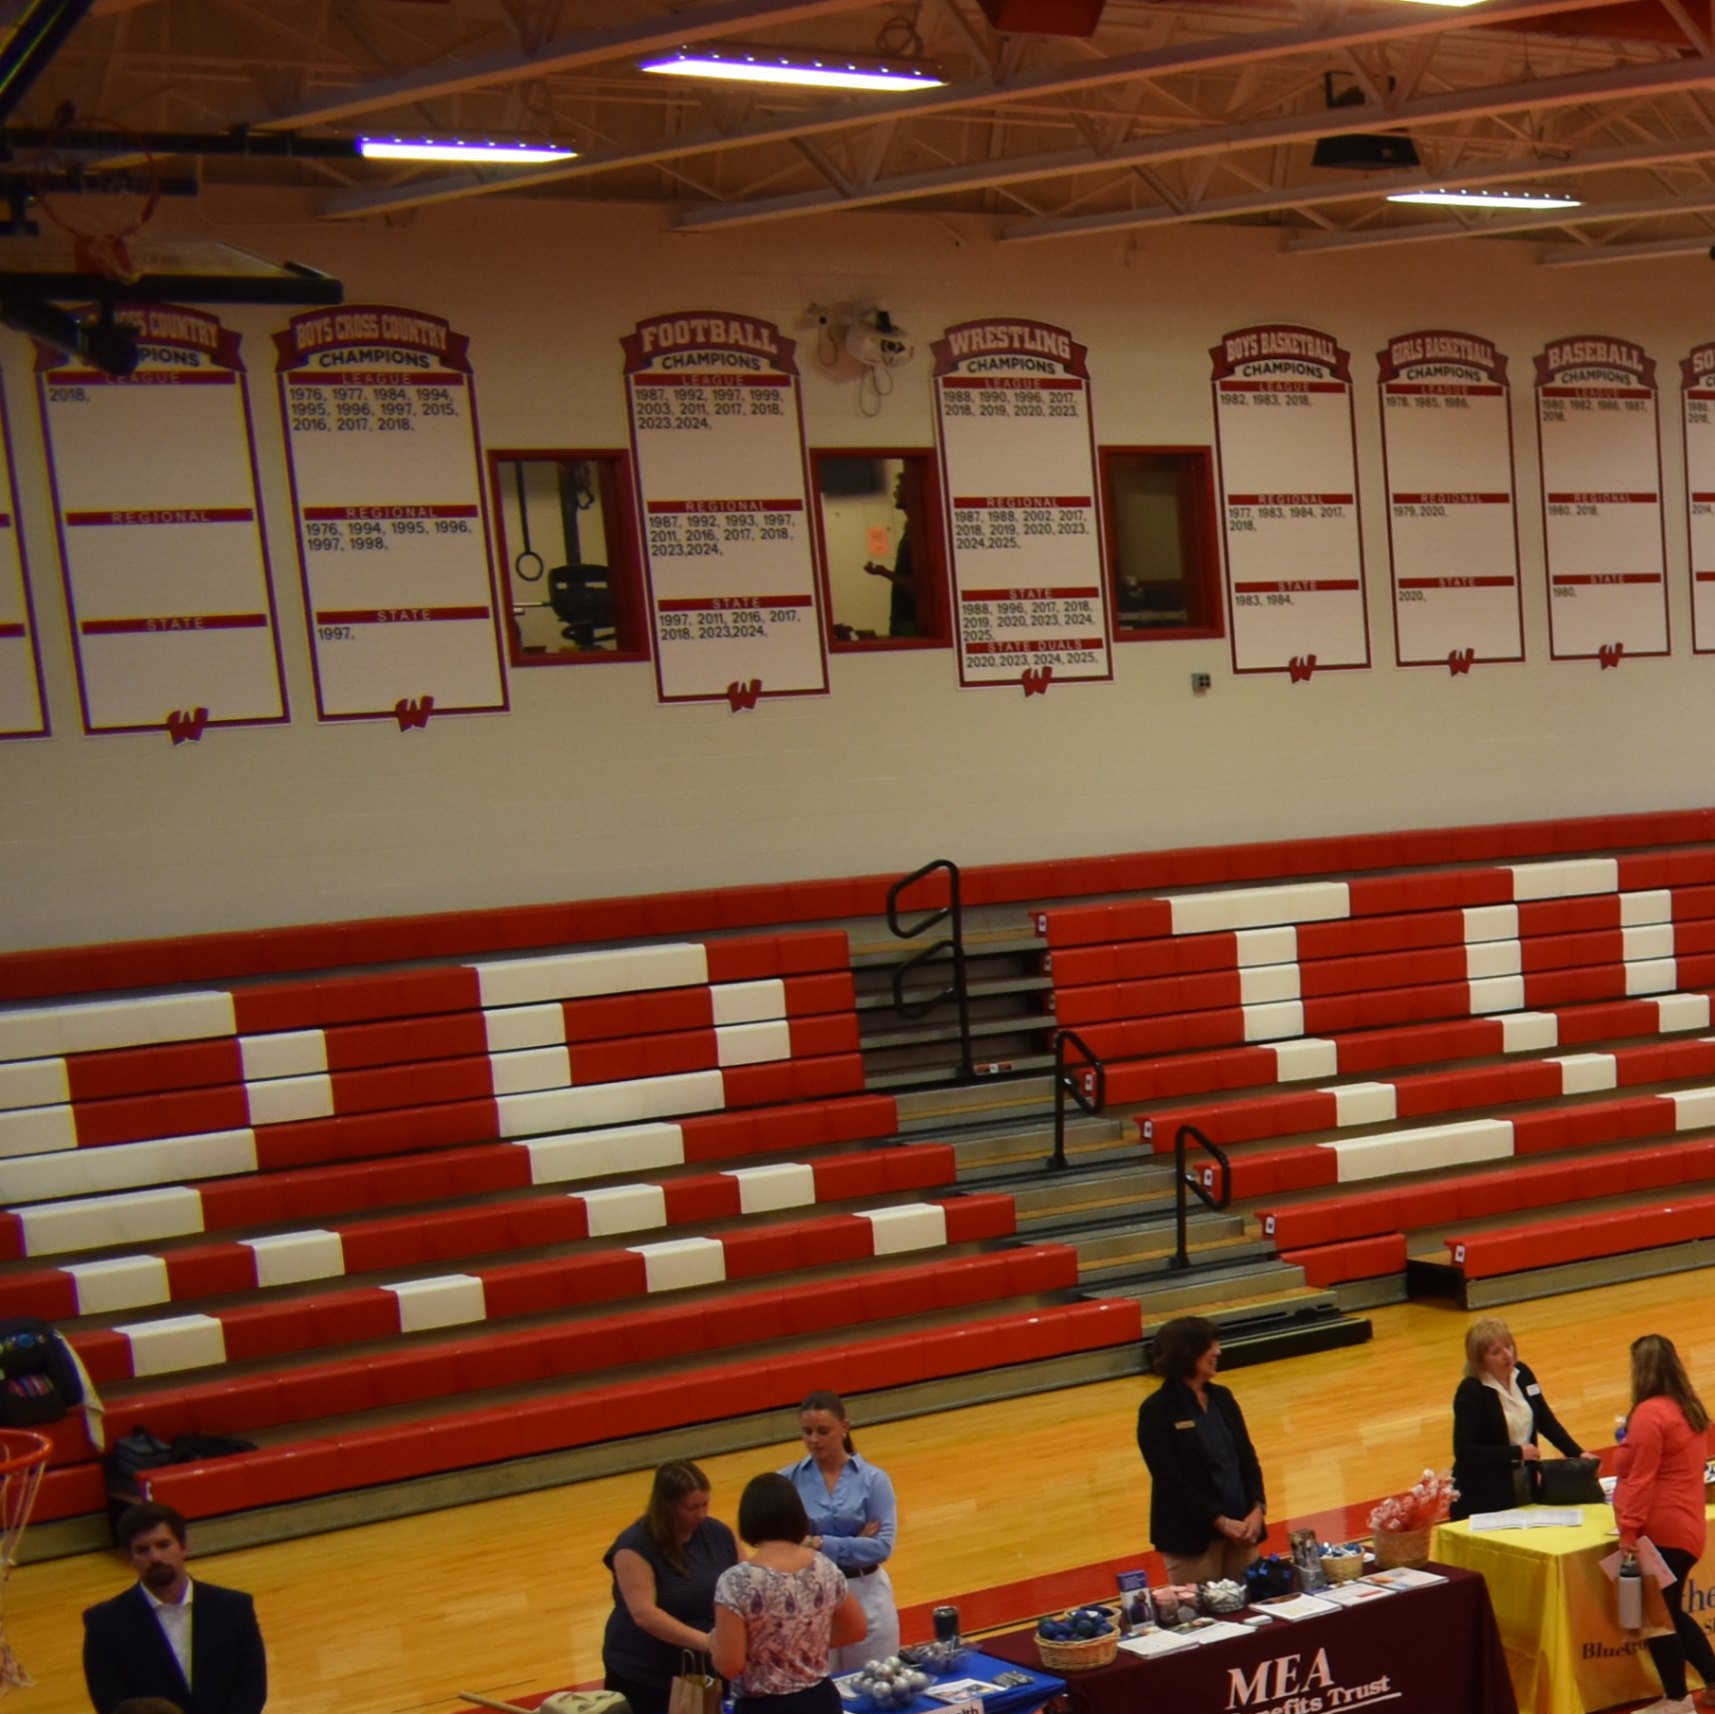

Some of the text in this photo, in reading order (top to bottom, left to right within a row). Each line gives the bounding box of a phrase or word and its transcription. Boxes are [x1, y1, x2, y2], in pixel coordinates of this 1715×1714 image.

[296, 315, 448, 349] BOYS CROSS COUNTRY
[642, 319, 778, 354] FOOTBALL
[949, 326, 1071, 360] WRESTLING
[1227, 333, 1336, 364] BOYS BASKETBALL
[319, 349, 430, 369] CHAMPIONS
[1424, 337, 1495, 367] BASKETBALL
[1547, 341, 1644, 371] BASEBALL
[662, 353, 761, 370] CHAMPIONS
[967, 357, 1057, 375] CHAMPIONS
[1242, 362, 1323, 379] CHAMPIONS
[1407, 365, 1481, 381] CHAMPIONS
[1561, 370, 1632, 385] CHAMPIONS
[342, 372, 411, 385] LEAGUE
[682, 375, 744, 386] LEAGUE
[985, 378, 1041, 388] LEAGUE
[685, 500, 768, 512] REGIONAL
[987, 497, 1059, 507] REGIONAL
[111, 509, 210, 523] REGIONAL
[346, 506, 438, 519] REGIONAL
[1010, 589, 1053, 600] STATE
[712, 597, 760, 609] STATE
[377, 609, 431, 622] STATE
[146, 617, 205, 631] STATE
[988, 640, 1083, 654] STATE DUALS
[1224, 1647, 1335, 1710] MEA
[1327, 1674, 1392, 1706] Trust
